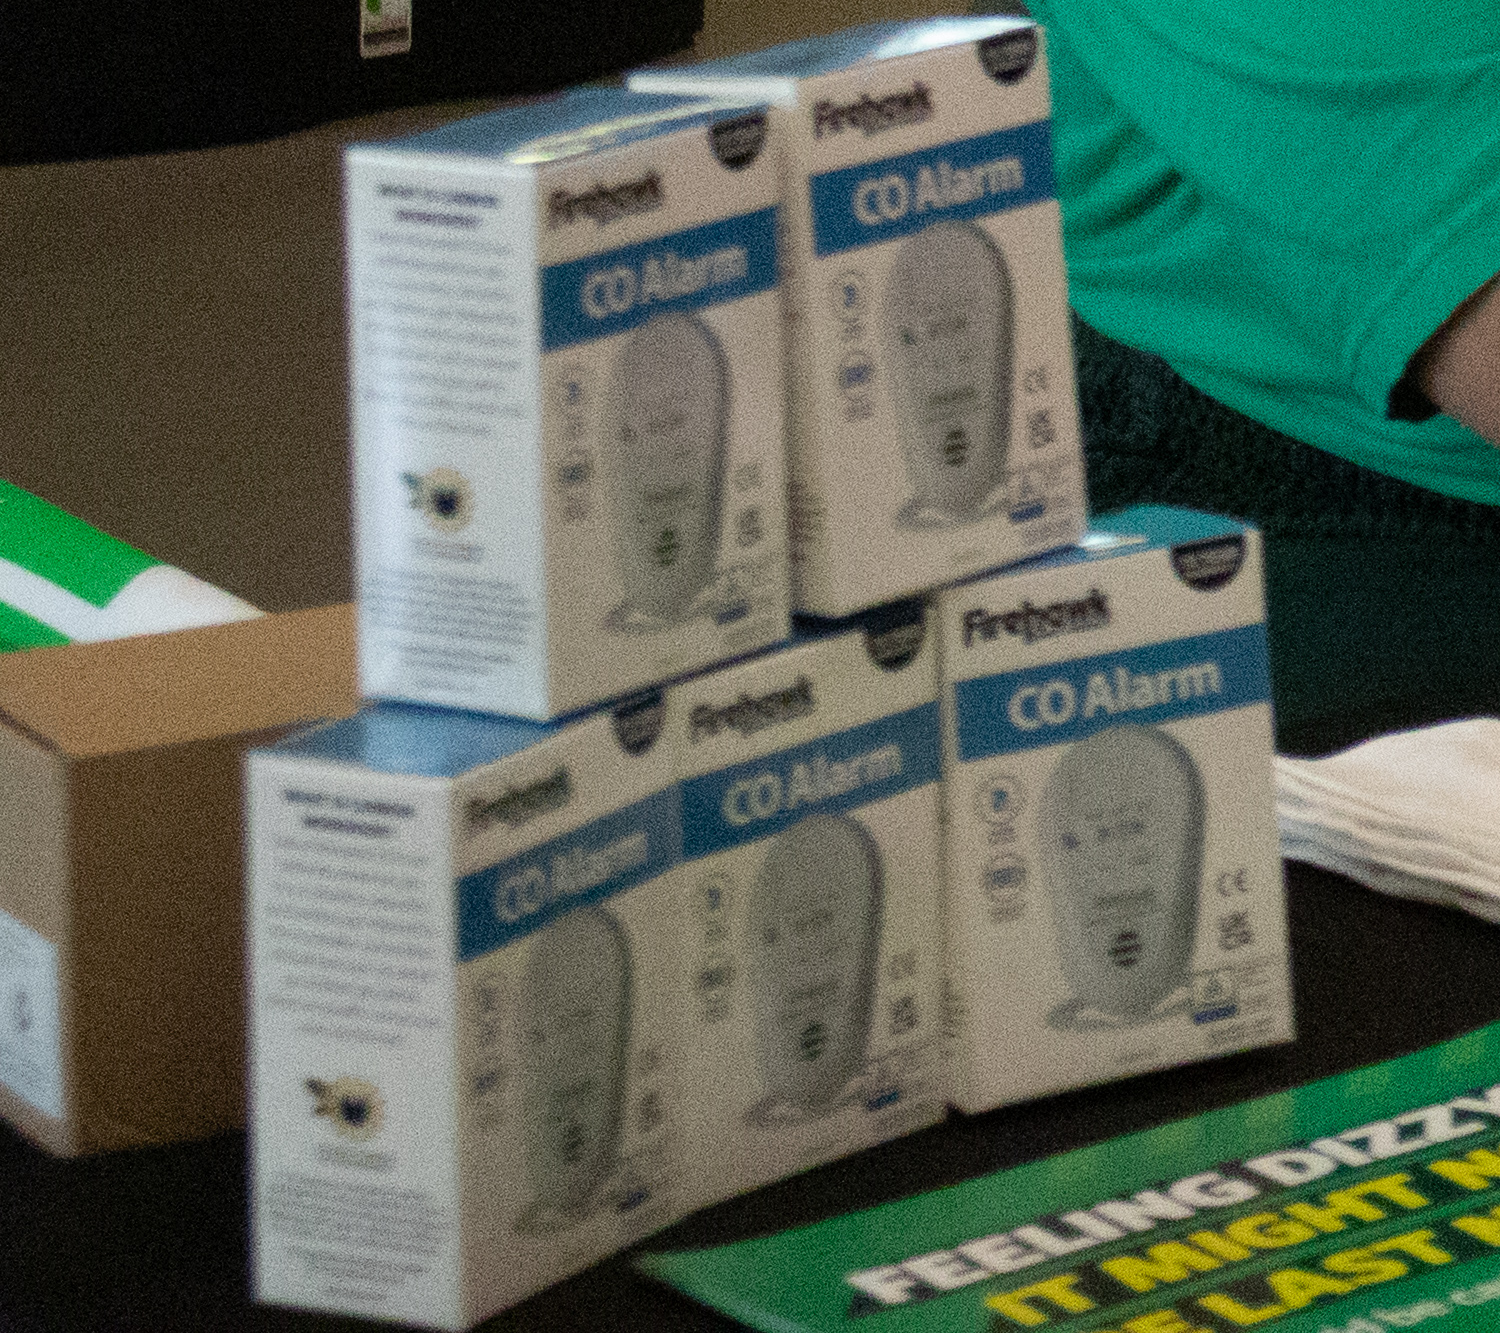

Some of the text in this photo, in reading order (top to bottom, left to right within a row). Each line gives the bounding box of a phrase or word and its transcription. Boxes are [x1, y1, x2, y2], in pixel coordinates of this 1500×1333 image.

[852, 156, 1025, 227] CO Alarm
[581, 246, 749, 320] CO Alarm
[962, 586, 1112, 647] Firehawk
[1009, 659, 1224, 733] CO Alarm
[722, 744, 906, 826] CO Alarm
[497, 831, 651, 925] CO Alarm
[848, 1171, 1262, 1305] FEELING
[985, 1273, 1097, 1327] IT
[1102, 1172, 1432, 1293] MIGHT
[1200, 1229, 1454, 1326] LAST
